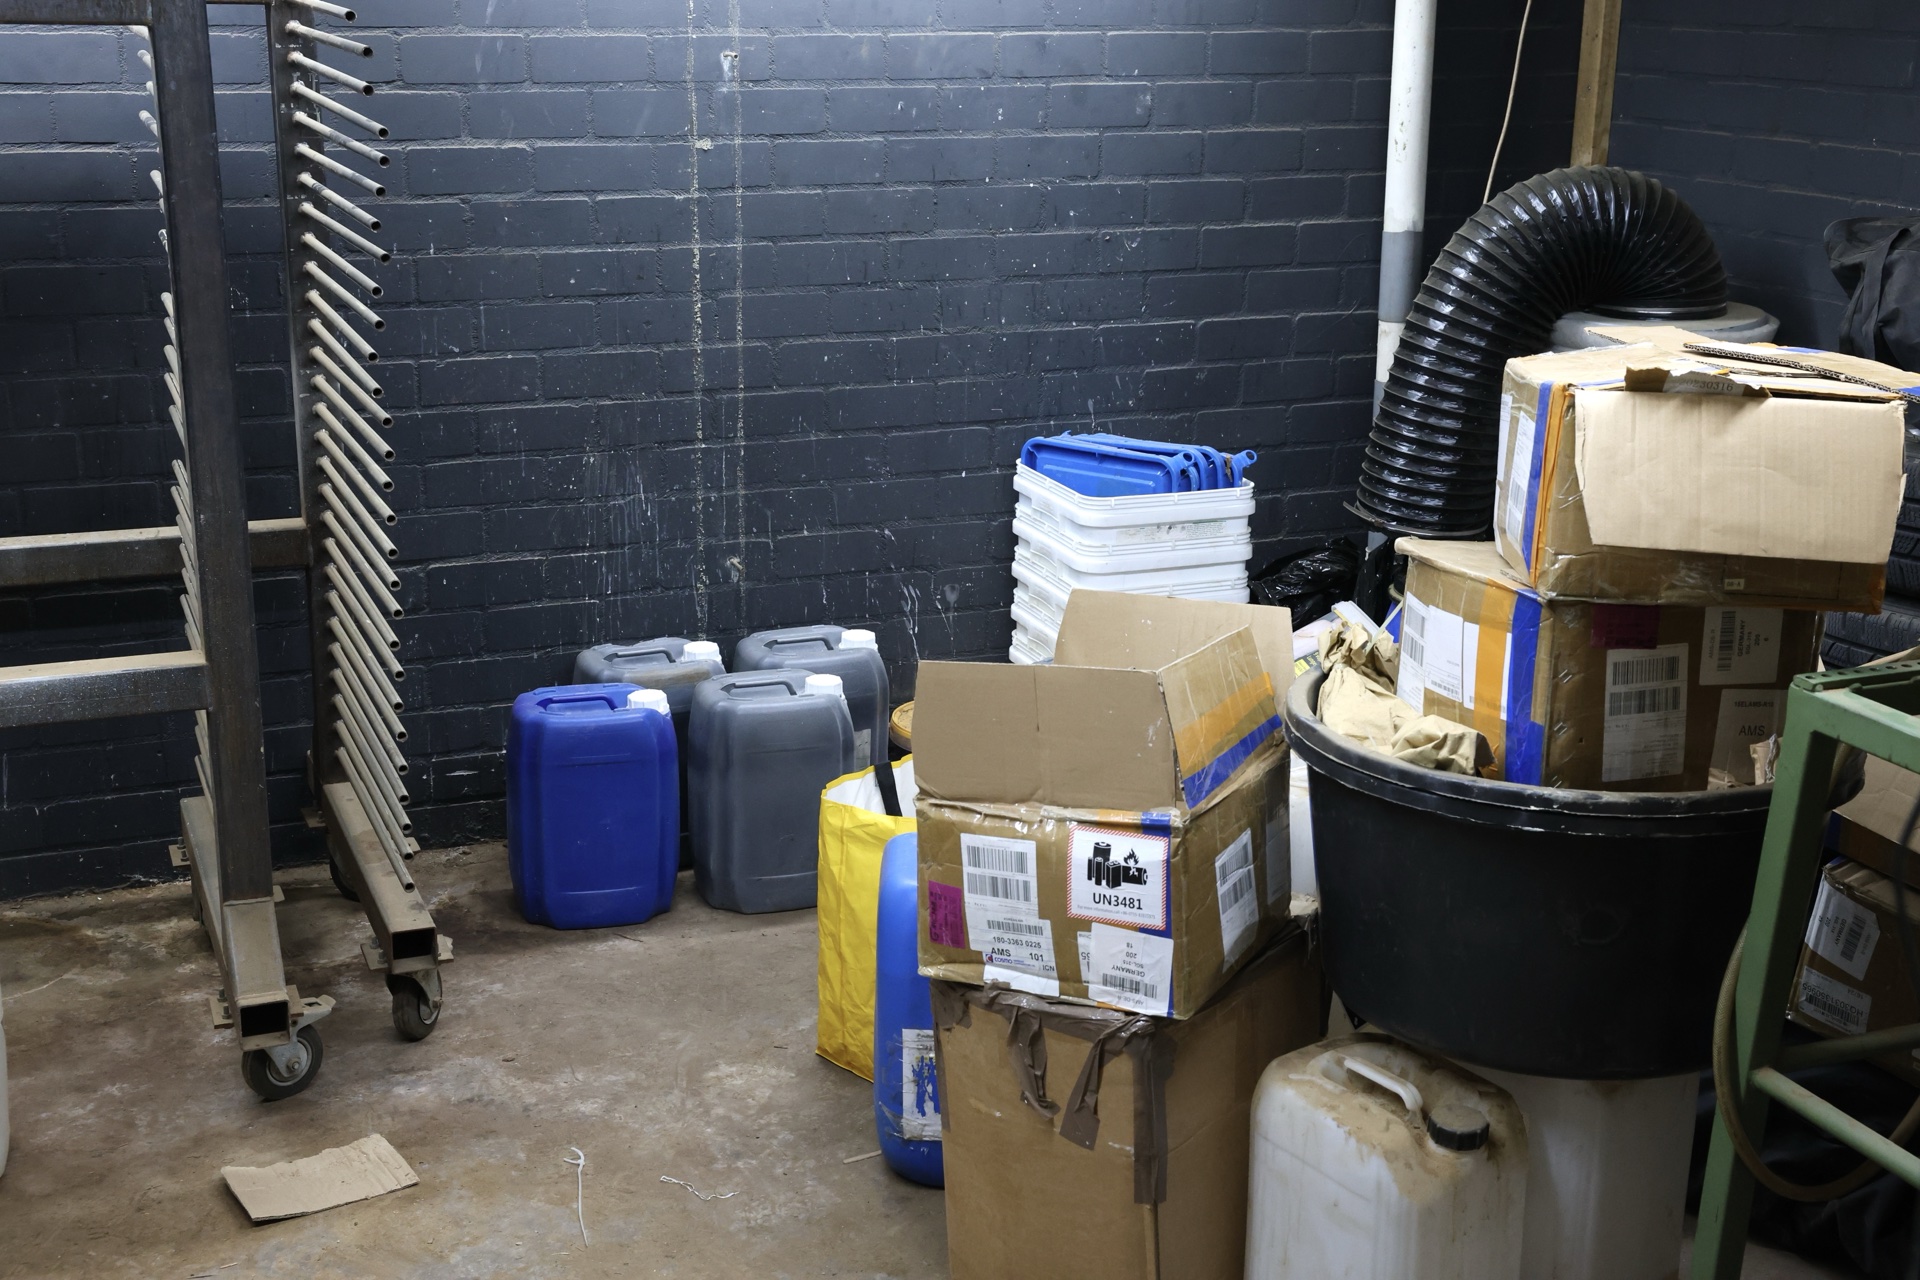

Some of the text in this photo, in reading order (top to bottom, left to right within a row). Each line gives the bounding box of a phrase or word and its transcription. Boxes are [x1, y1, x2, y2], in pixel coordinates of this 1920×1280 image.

[1737, 619, 1746, 657] GERMANY
[1739, 725, 1766, 736] AMS
[1092, 892, 1143, 910] UN3481
[1834, 918, 1848, 948] GERMANY
[993, 936, 1042, 949] 180-3363 0225
[991, 947, 1044, 962] AMS 101
[1125, 951, 1137, 959] 200
[1042, 964, 1055, 972] ICN
[1122, 959, 1144, 969] SGL-315
[1111, 965, 1146, 978] GERMANY
